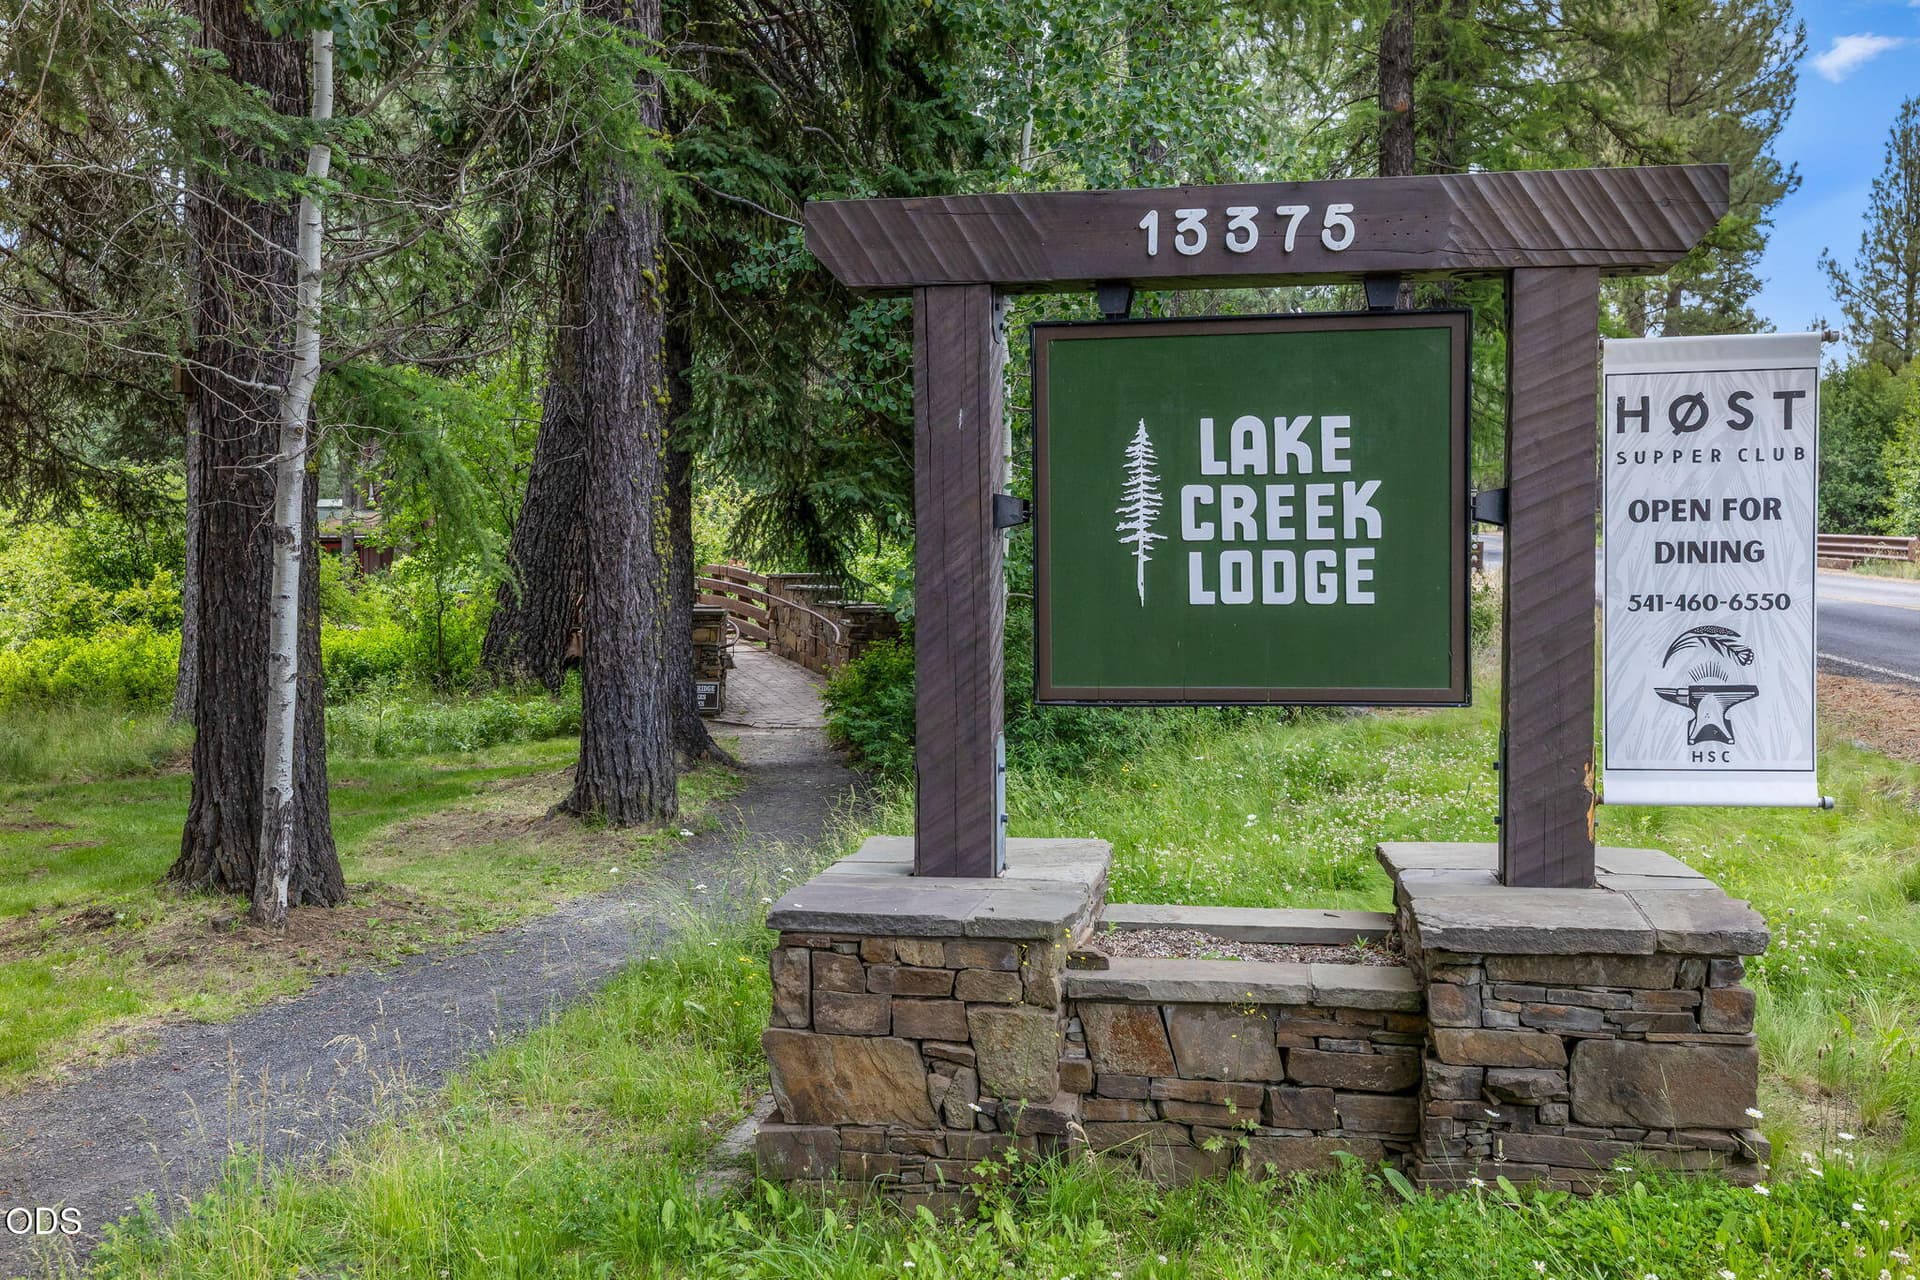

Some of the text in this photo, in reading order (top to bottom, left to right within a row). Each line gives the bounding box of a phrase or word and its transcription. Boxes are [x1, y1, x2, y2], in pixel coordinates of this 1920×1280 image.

[1139, 203, 1356, 256] 13375
[1616, 390, 1806, 436] HØST
[1199, 415, 1351, 475] LAKE
[1616, 447, 1805, 465] SUPPER CLUB
[1181, 480, 1382, 541] CREEK
[1628, 497, 1782, 523] OPEN FOR
[1655, 540, 1765, 564] DINING
[1189, 547, 1376, 605] LODGE
[1627, 593, 1791, 612] 541-460-6550
[1691, 751, 1730, 763] HSC
